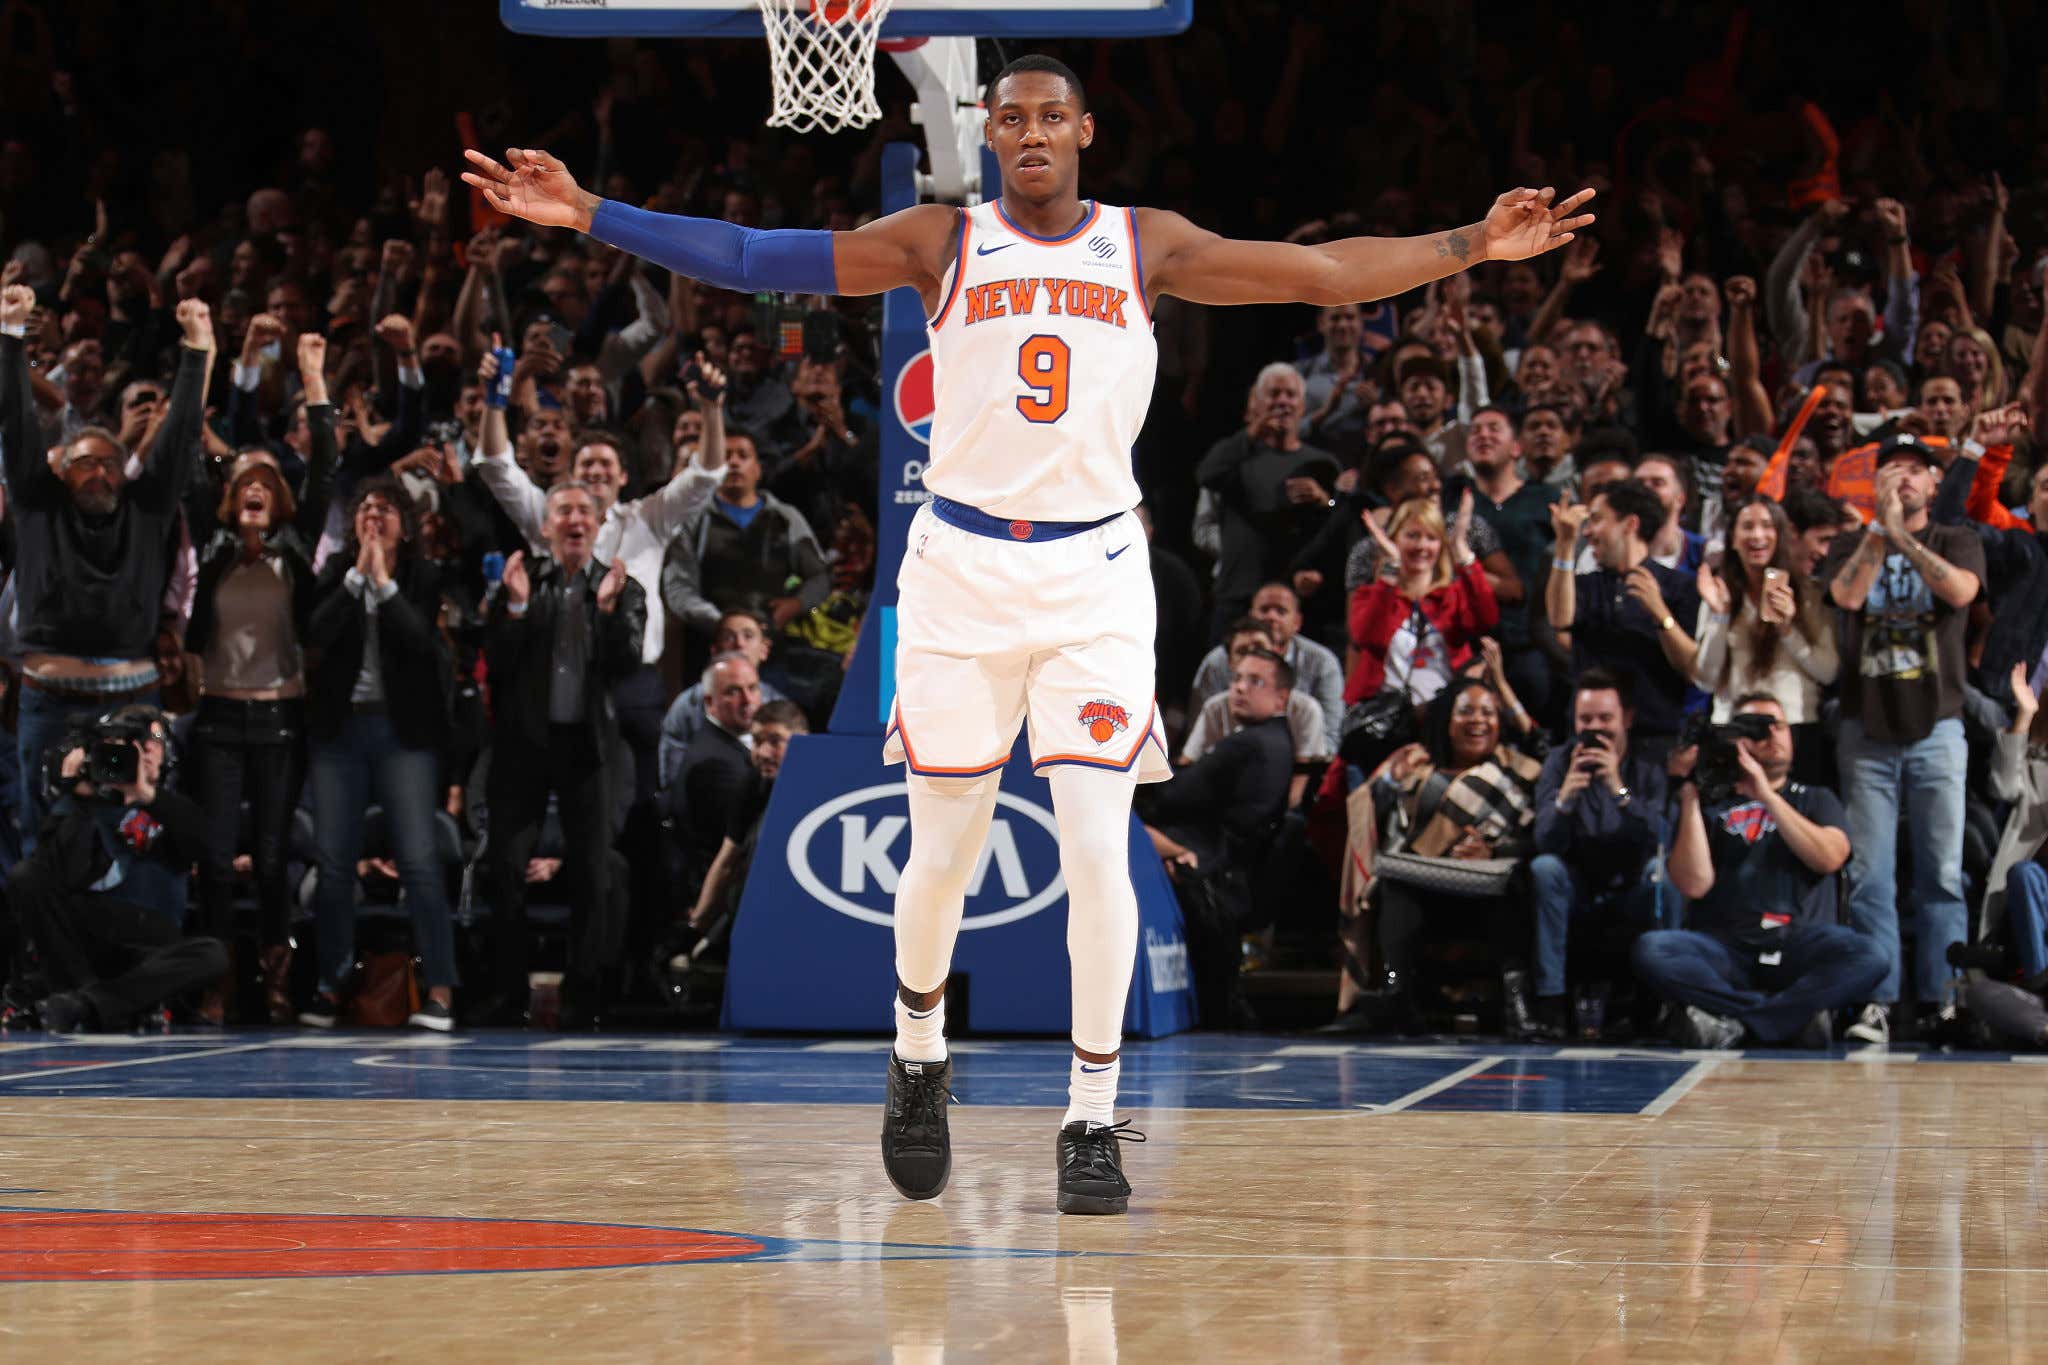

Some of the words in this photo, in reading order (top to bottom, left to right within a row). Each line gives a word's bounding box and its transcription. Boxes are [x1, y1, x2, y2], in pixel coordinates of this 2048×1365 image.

[965, 278, 1039, 327] NEW
[1042, 278, 1128, 329] YORK
[1016, 334, 1071, 424] 9
[838, 814, 1031, 898] KA
